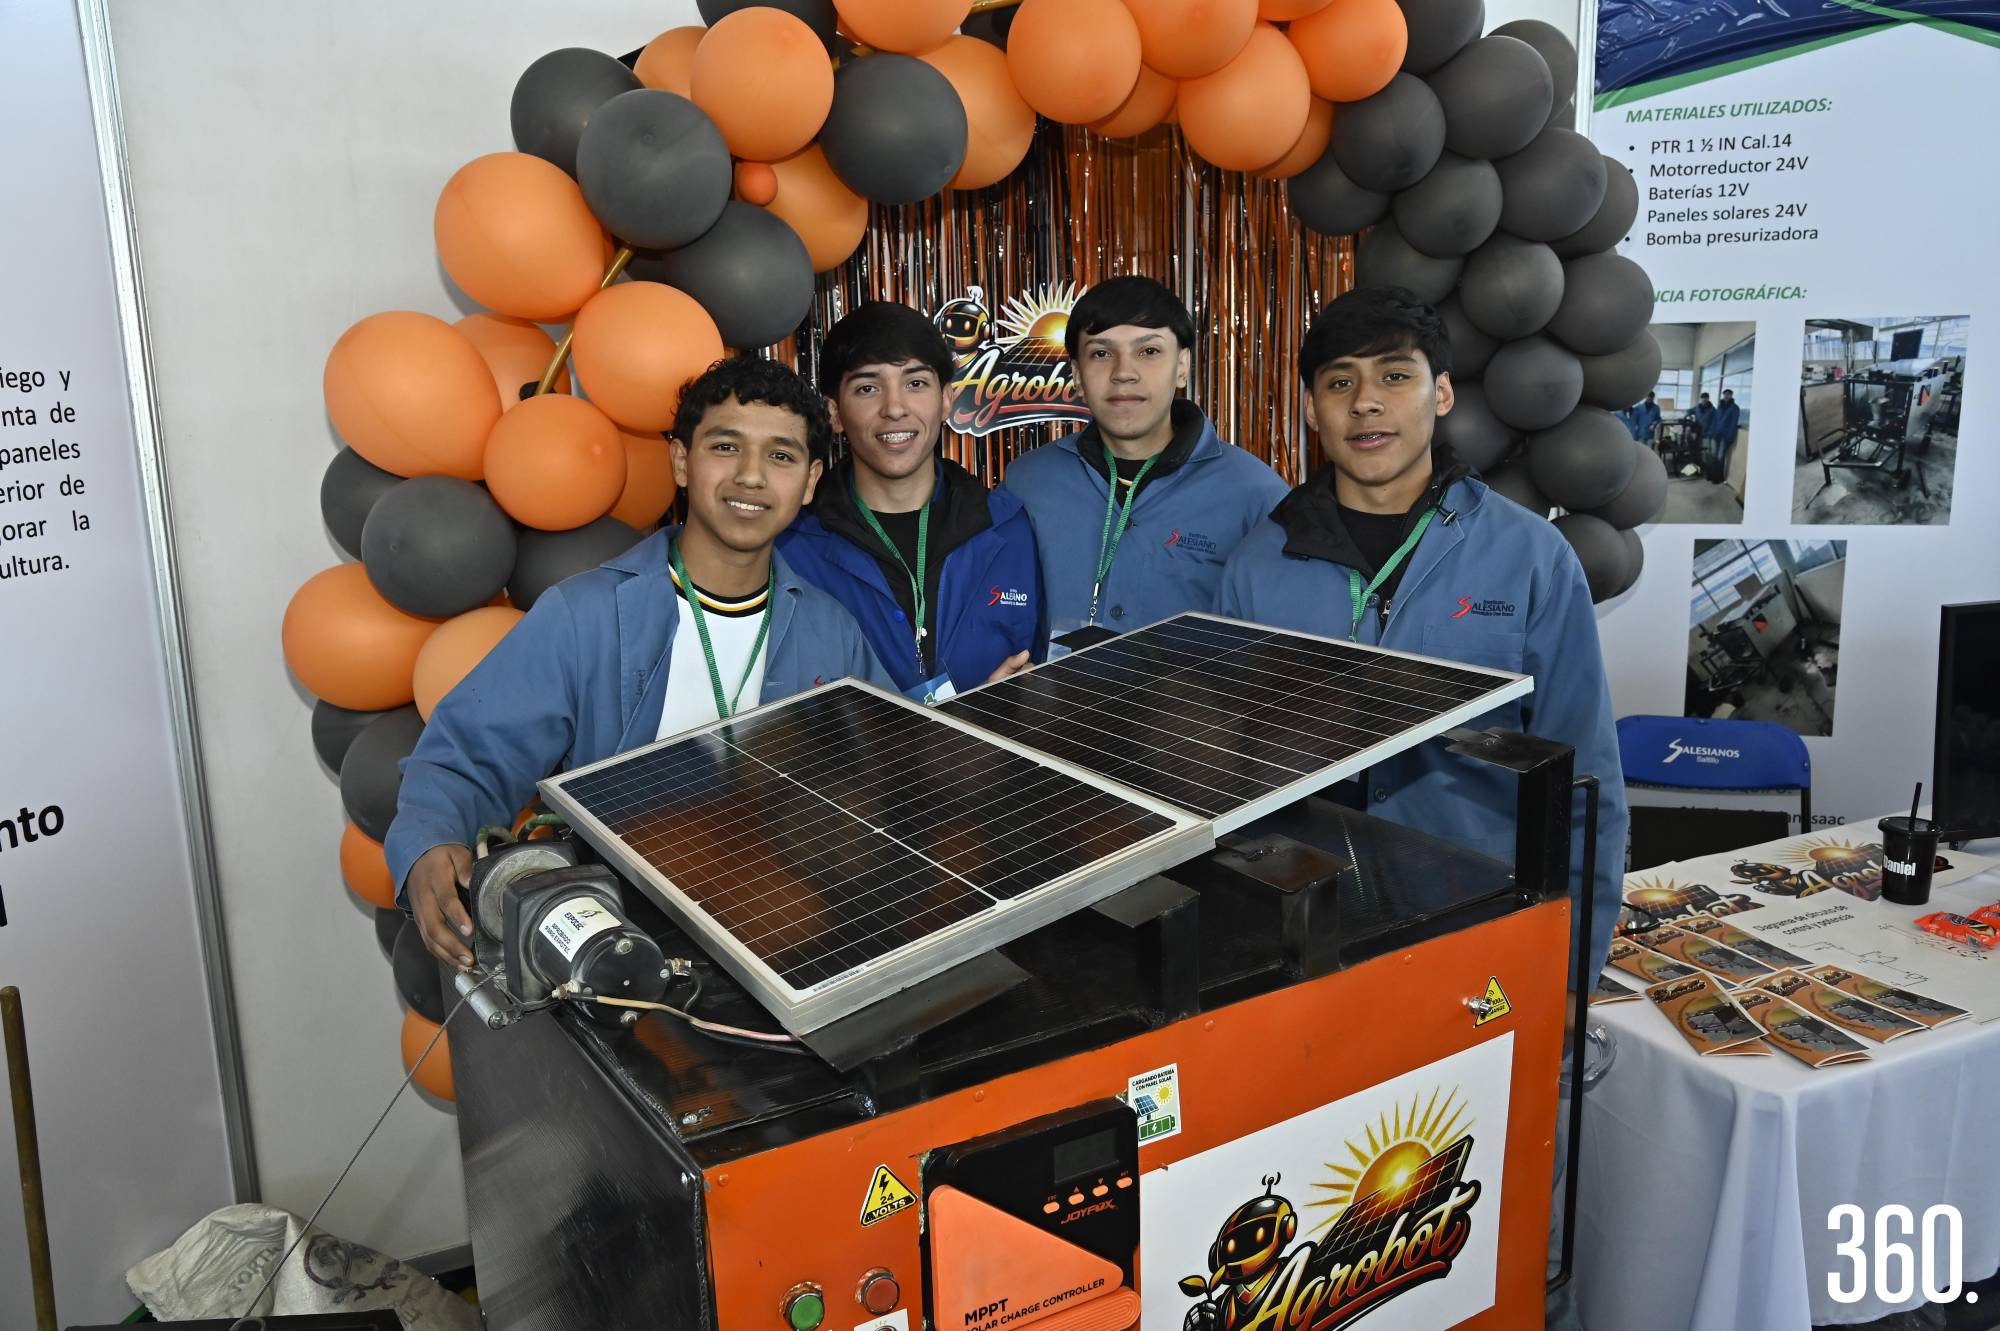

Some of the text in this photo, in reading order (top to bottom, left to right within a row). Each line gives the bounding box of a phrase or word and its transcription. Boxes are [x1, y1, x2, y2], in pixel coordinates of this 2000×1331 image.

[1625, 98, 1832, 123] MATERIALES UTILIZADOS:
[1651, 139, 1681, 155] PTR
[1686, 139, 1694, 153] 1
[1718, 136, 1736, 151] IN
[1741, 133, 1792, 150] Cal.14
[1649, 156, 1809, 177] Motorreductor 24V
[1648, 182, 1750, 201] Baterías 12V
[1647, 203, 1808, 224] Paneles solares 24V
[1646, 227, 1819, 247] Bomba presurizadora
[1689, 283, 1808, 302] FOTOGRÁFICA:
[59, 370, 71, 391] y
[952, 348, 1078, 428] Agrobo
[50, 401, 76, 424] de
[0, 438, 81, 470] paneles
[59, 473, 85, 496] de
[0, 509, 90, 546] orar la
[1450, 596, 1516, 619] SALESIANO
[1662, 738, 1740, 763] SALESIANOS
[1811, 815, 1845, 826] saac
[1883, 854, 1916, 877] Daniel
[1132, 1074, 1158, 1087] CARGANDO
[1135, 1075, 1172, 1092] CON PANEL SOLAR
[872, 1198, 906, 1218] VOLTS
[880, 1192, 895, 1206] 24
[1240, 1184, 1478, 1331] Agrobot
[964, 1298, 1009, 1326] MPPT
[1000, 1303, 1041, 1325] CHARGE
[1042, 1277, 1105, 1308] CONTROLLER
